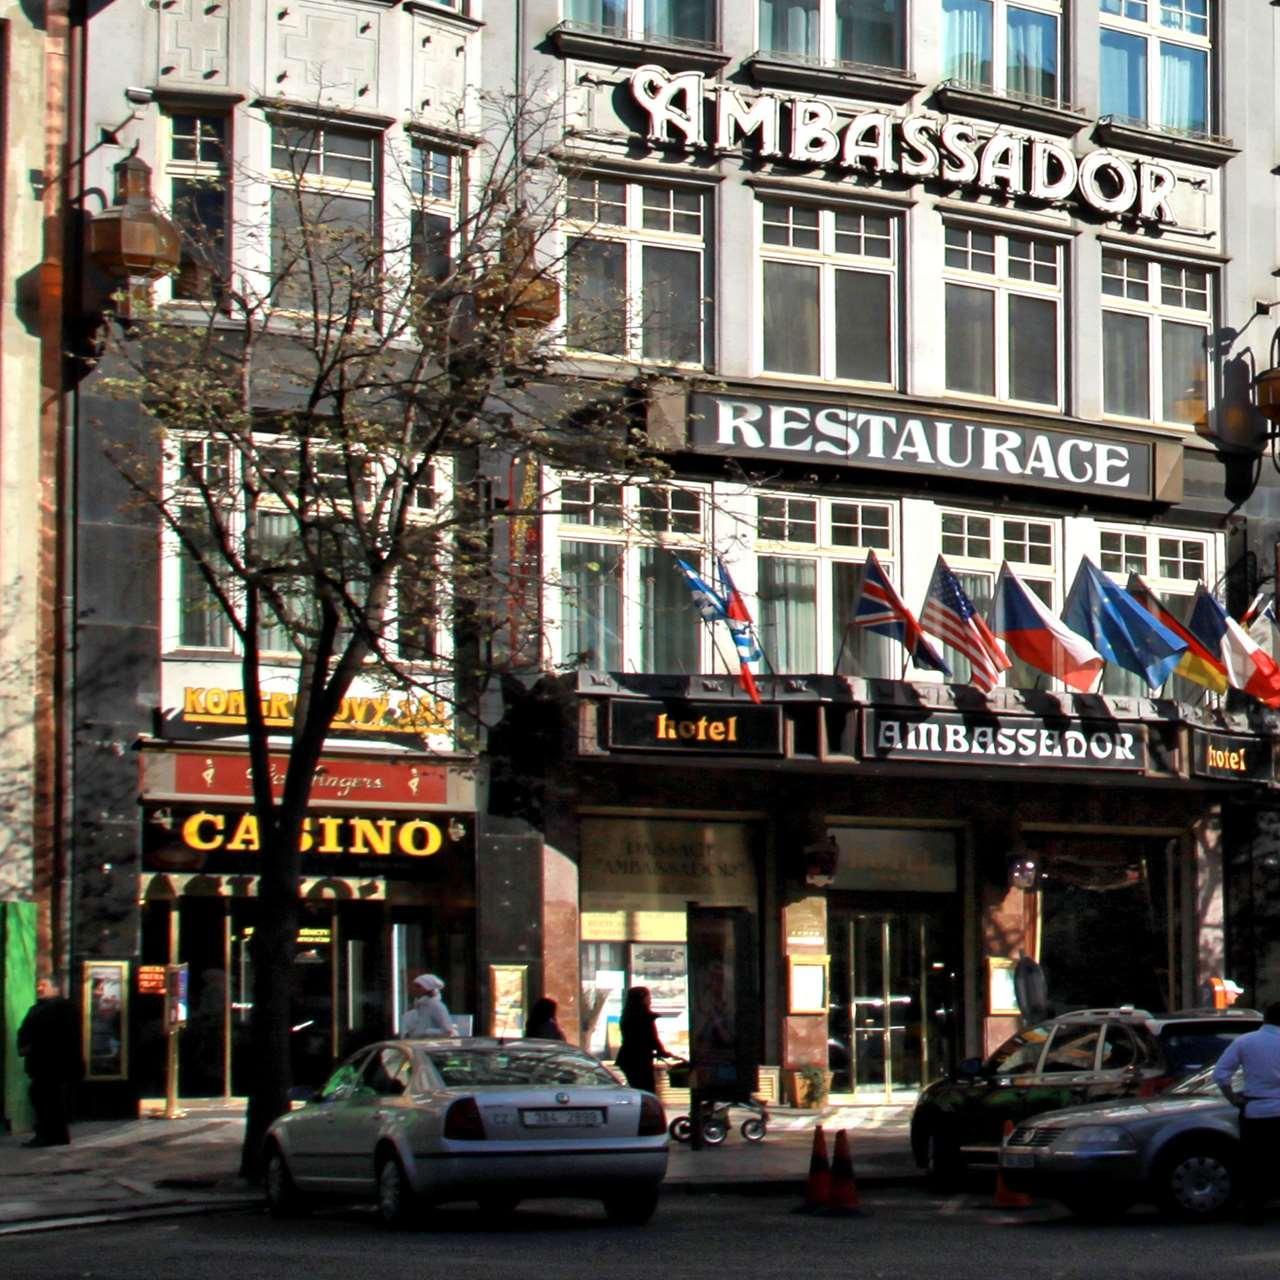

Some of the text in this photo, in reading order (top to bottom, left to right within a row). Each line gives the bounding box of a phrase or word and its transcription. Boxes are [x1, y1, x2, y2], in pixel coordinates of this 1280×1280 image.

[628, 65, 1180, 227] AMBASSADOR
[713, 397, 1132, 489] RESTAURACE
[656, 712, 739, 742] hotel
[877, 719, 1136, 762] AMBASSADOR
[1207, 744, 1247, 771] hotel
